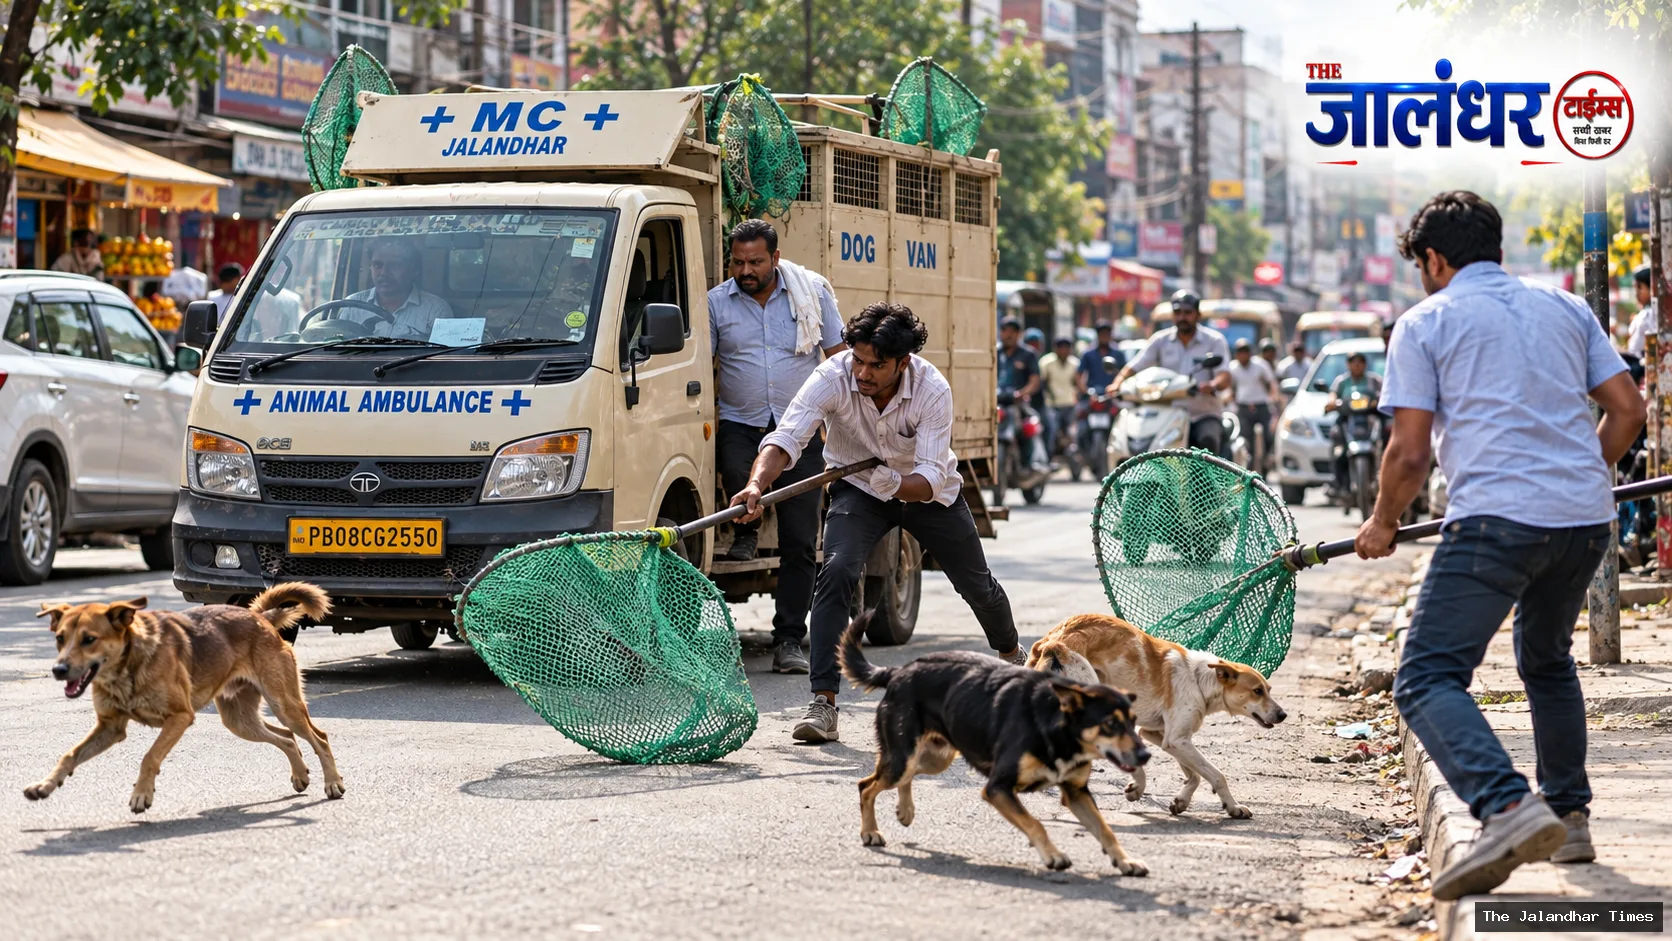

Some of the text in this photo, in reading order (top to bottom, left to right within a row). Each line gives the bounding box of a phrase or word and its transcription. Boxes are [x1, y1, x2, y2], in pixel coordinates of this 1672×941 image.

[470, 101, 567, 132] MC
[441, 136, 568, 157] JALANDHAR
[841, 231, 936, 270] DOG VAN
[269, 390, 493, 413] ANIMAL AMBULANCE
[309, 526, 438, 547] PB08CG2550
